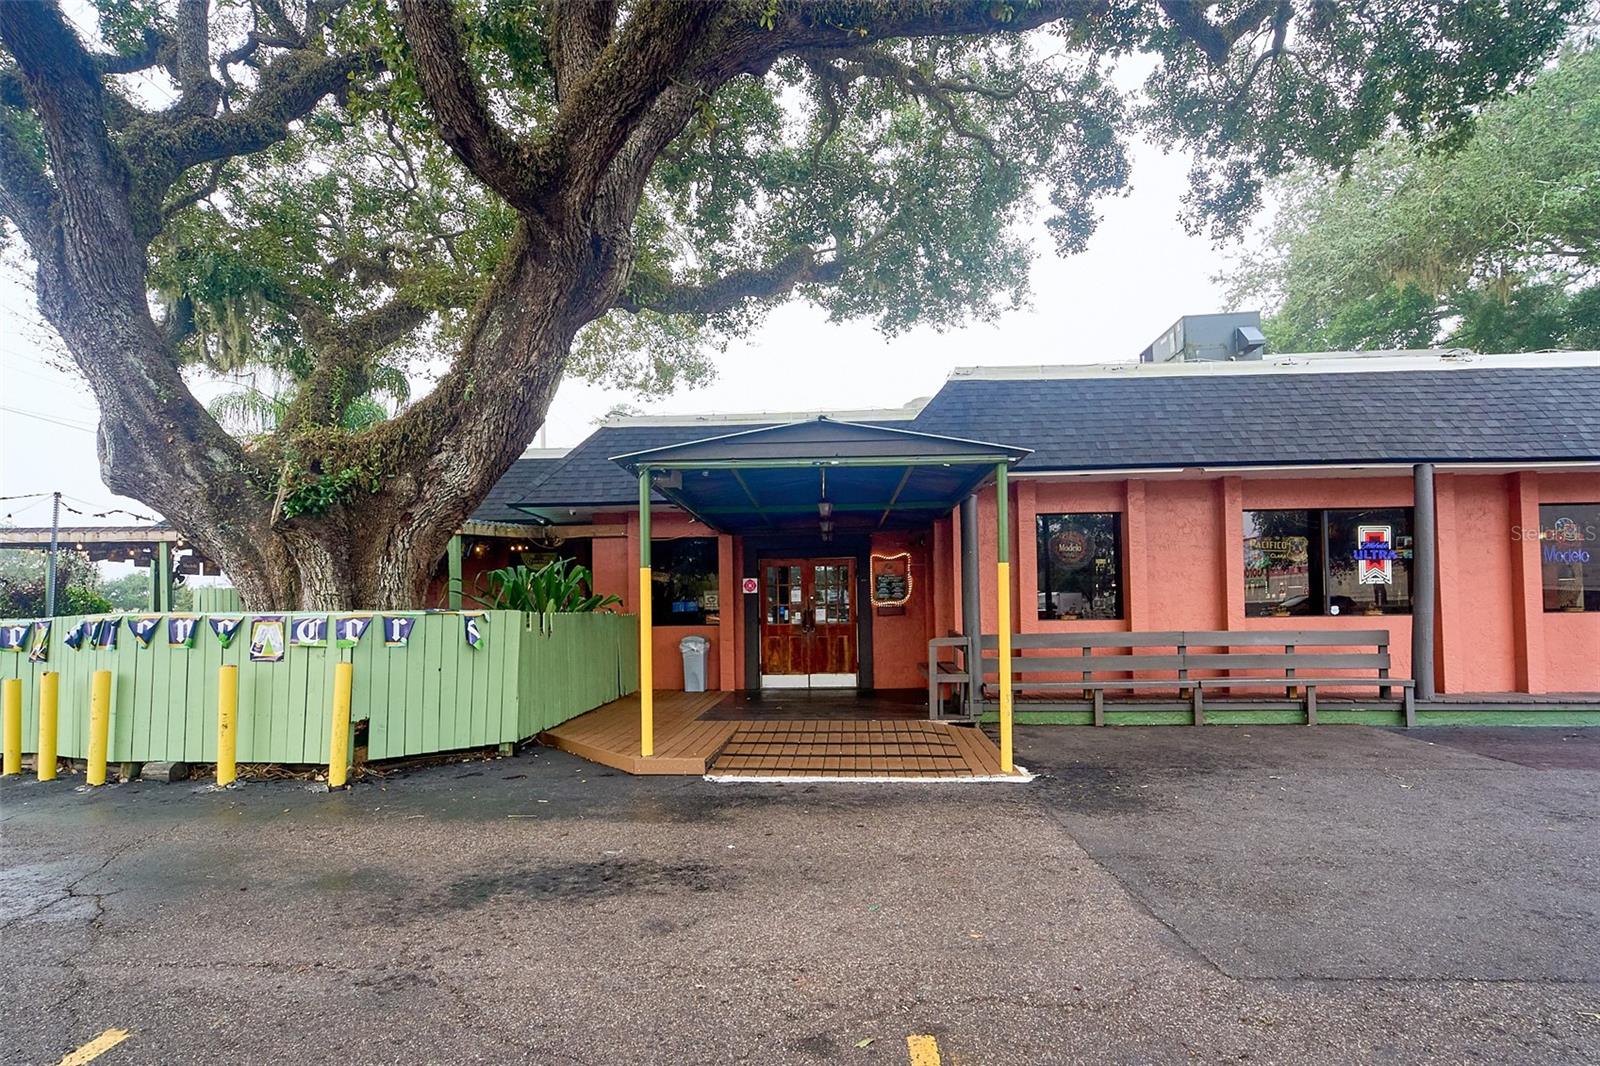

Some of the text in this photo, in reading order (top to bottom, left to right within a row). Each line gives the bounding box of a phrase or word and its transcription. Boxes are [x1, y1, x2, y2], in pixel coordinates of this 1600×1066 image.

[1058, 543, 1082, 552] Modelo
[1353, 549, 1397, 560] ULTRA
[1543, 545, 1590, 562] Modelo
